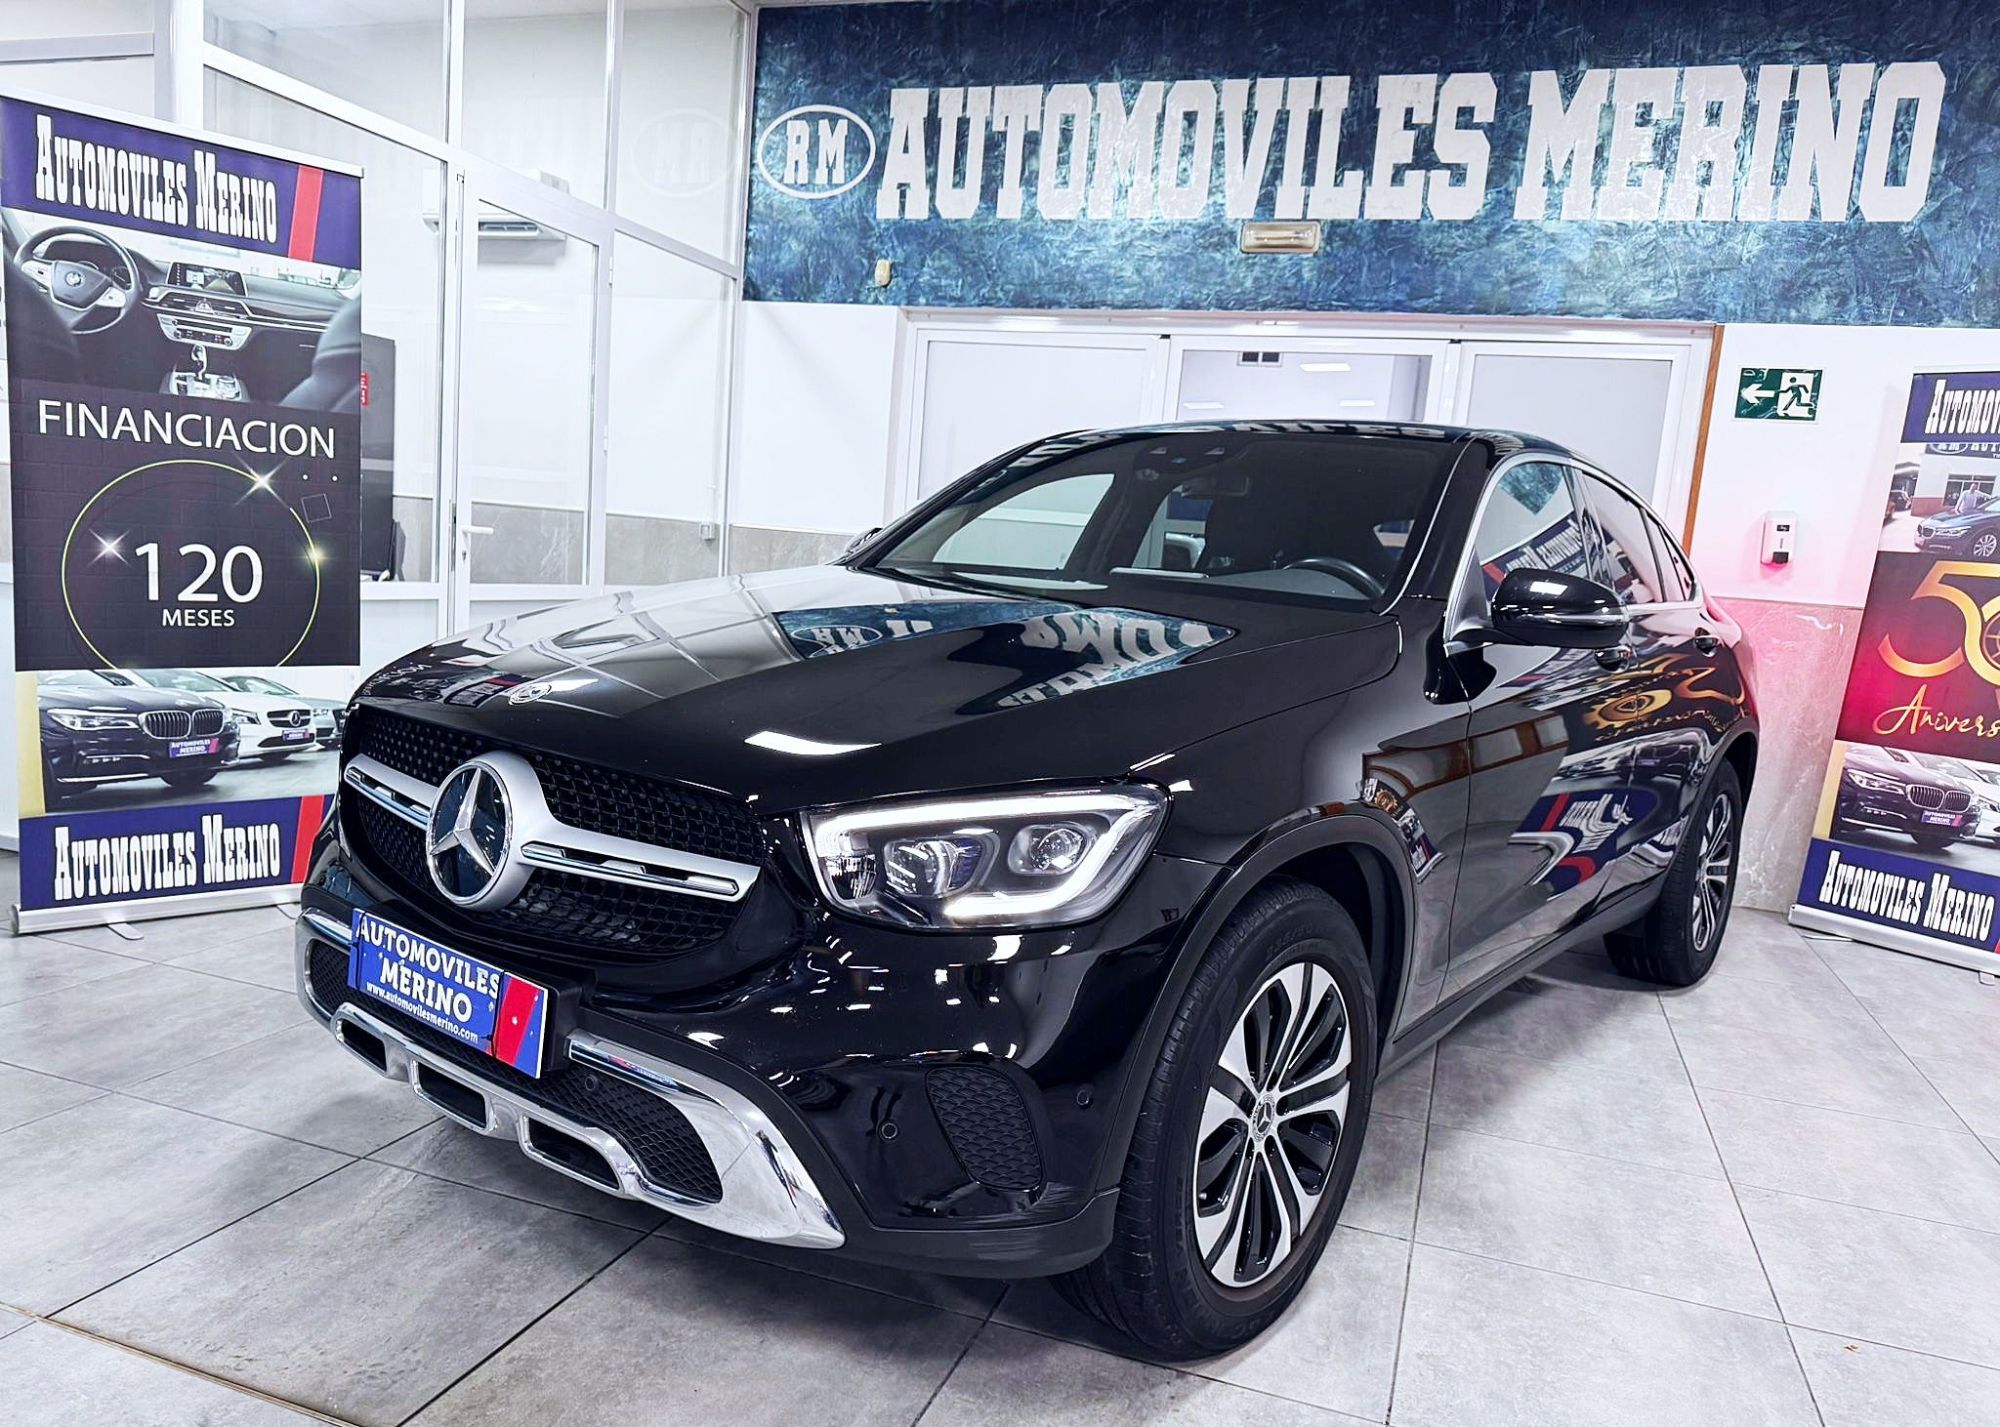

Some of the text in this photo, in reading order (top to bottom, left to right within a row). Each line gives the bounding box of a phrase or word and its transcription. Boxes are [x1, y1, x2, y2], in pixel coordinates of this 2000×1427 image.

[36, 114, 277, 244] AUTOMOVILES MERINO
[783, 61, 1945, 222] RM AUTOMOVILES MERINO
[38, 399, 335, 459] FINANCIACION
[135, 543, 264, 603] 120
[162, 609, 235, 627] MESES
[54, 815, 280, 900] AUTOMOVILES MERINO
[1819, 850, 1995, 942] AUTOMOVILES MERINO
[356, 914, 500, 1000] AUTOMOVILES
[380, 957, 472, 1022] MERINO
[366, 981, 478, 1044] www.automovilesmerino.com
